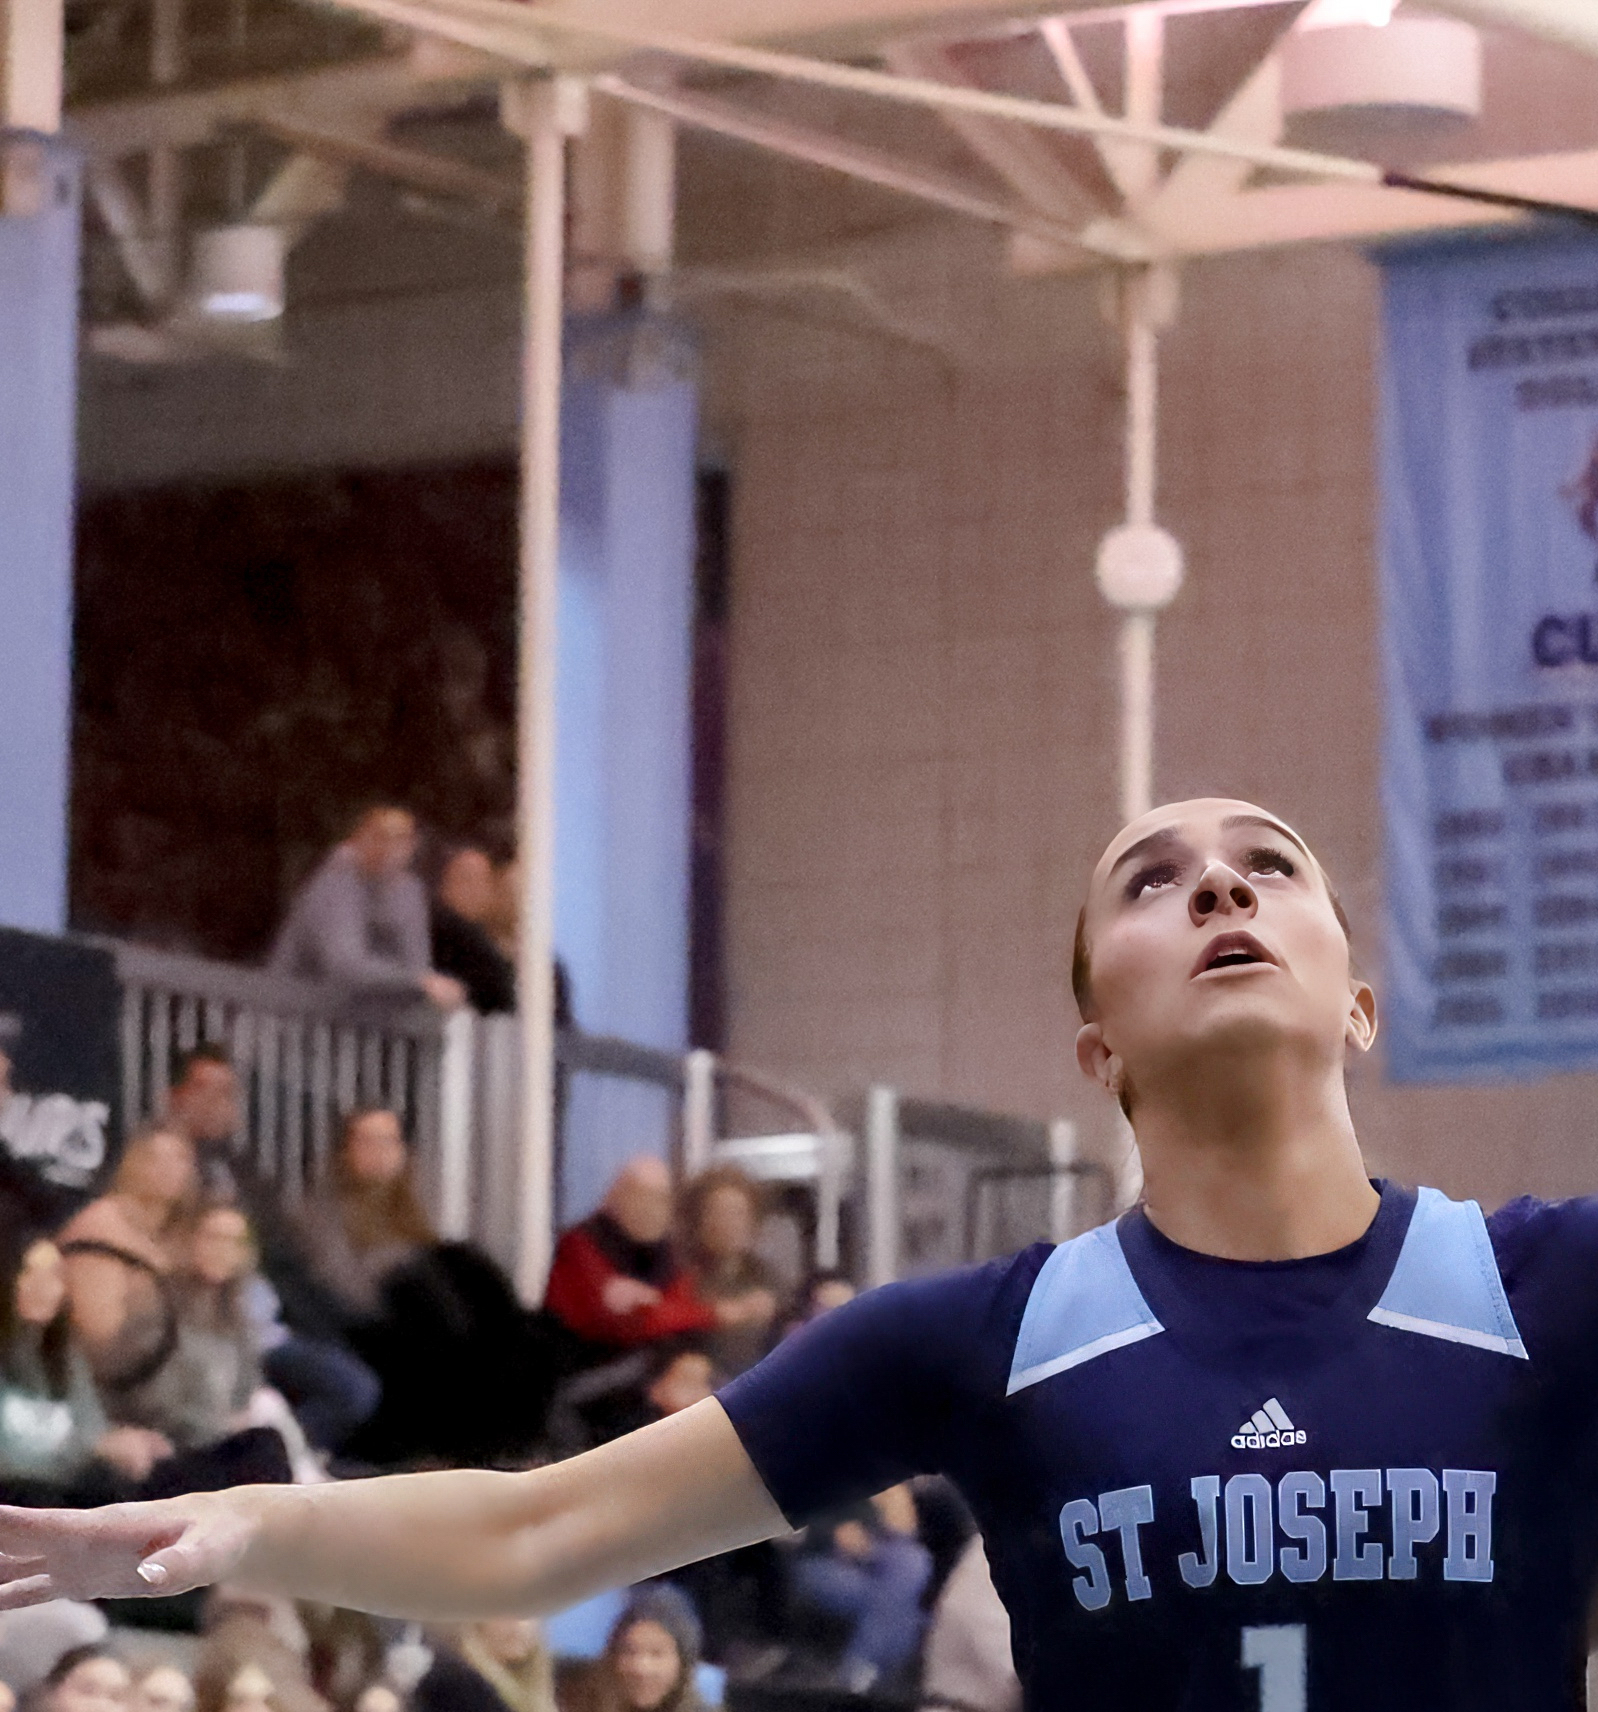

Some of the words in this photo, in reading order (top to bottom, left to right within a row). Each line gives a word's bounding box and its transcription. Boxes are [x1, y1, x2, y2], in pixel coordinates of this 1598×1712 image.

[1231, 1429, 1307, 1449] adidas
[1059, 1484, 1154, 1611] ST
[1178, 1468, 1497, 1588] JOSEPH
